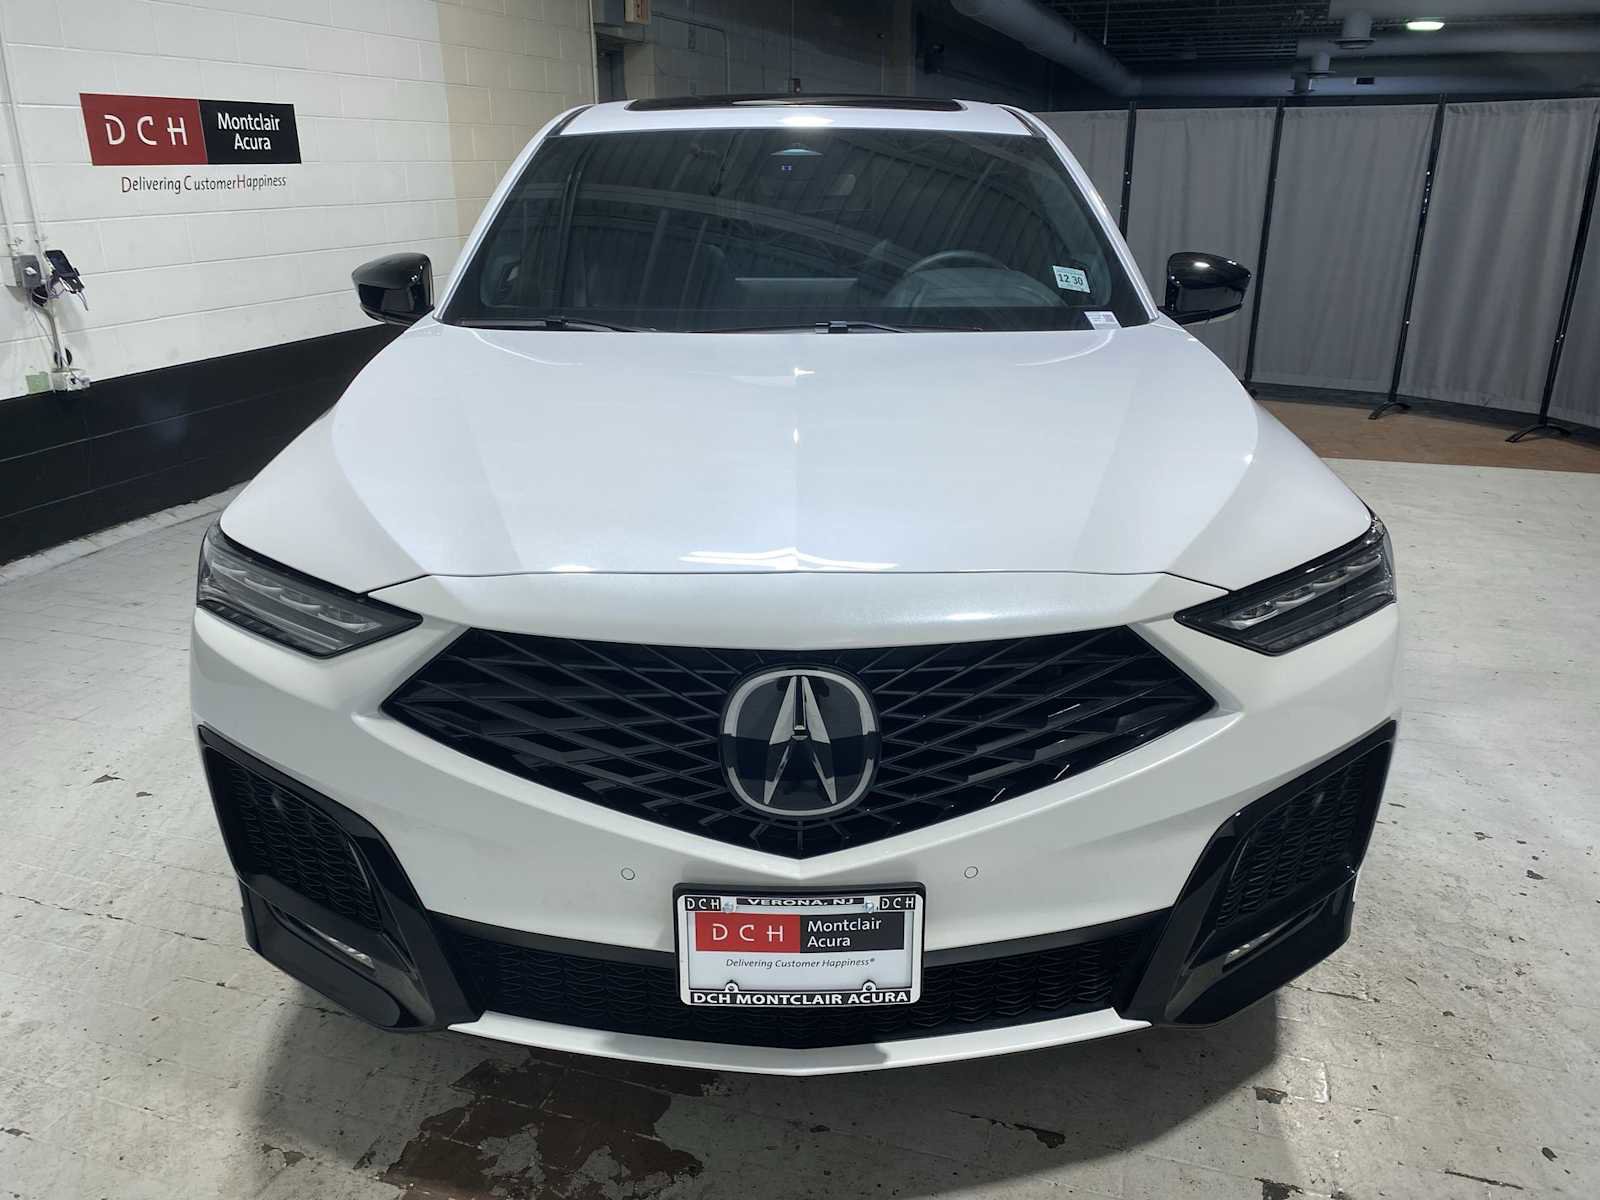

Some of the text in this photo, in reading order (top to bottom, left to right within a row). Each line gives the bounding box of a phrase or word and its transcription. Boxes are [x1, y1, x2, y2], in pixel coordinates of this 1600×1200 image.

[217, 112, 280, 131] Montclair
[104, 114, 188, 146] DCH
[234, 133, 272, 150] Acura
[121, 174, 287, 194] Delivering Customer Happiness
[1057, 273, 1070, 283] 12
[687, 899, 720, 910] DCH
[748, 898, 855, 906] VERONA, NJ
[881, 897, 915, 909] DCH
[712, 923, 784, 942] DCH
[807, 917, 882, 933] Montclair
[807, 934, 851, 948] Acura
[726, 958, 773, 970] Delivering
[775, 959, 819, 968] Customer
[693, 991, 909, 1006] DCH MONTCLAIR ACURA
